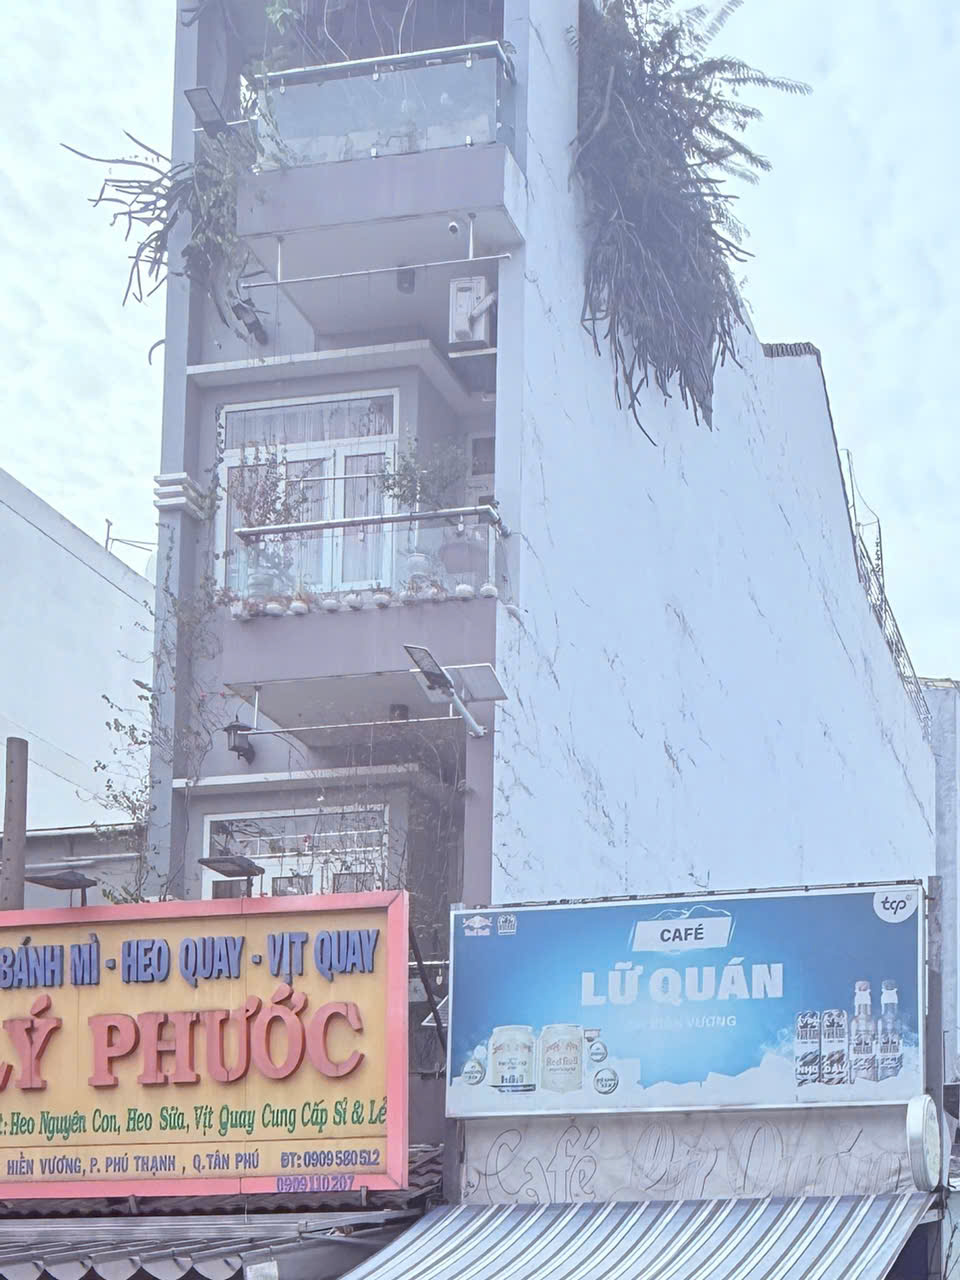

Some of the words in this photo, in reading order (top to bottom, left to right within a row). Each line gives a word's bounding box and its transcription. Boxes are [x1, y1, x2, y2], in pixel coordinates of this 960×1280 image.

[881, 896, 907, 915] tcp
[660, 923, 704, 942] CAFÉ
[0, 936, 64, 990] BÁNH
[70, 933, 100, 986] MÌ
[122, 938, 170, 984] HEO
[179, 936, 245, 988] QUAY
[268, 931, 309, 985] VỊT
[314, 928, 380, 983] QUAY
[581, 961, 643, 1007] LỮ
[649, 957, 784, 1006] QUÁN
[0, 994, 62, 1092] Ý
[88, 982, 365, 1088] PHƯỚC
[9, 1112, 35, 1136] Heo
[38, 1110, 87, 1142] Nguyên
[92, 1108, 121, 1135] Con,
[126, 1108, 152, 1132] Heo
[193, 1105, 213, 1136] Vịt
[218, 1104, 255, 1136] Quay
[262, 1103, 297, 1133] Cung
[301, 1099, 328, 1133] Cấp
[352, 1100, 364, 1124] &
[40, 1154, 86, 1176] VƯƠNG,
[90, 1157, 100, 1173] P.
[105, 1153, 129, 1173] PHÚ
[235, 1149, 259, 1170] PHÚ
